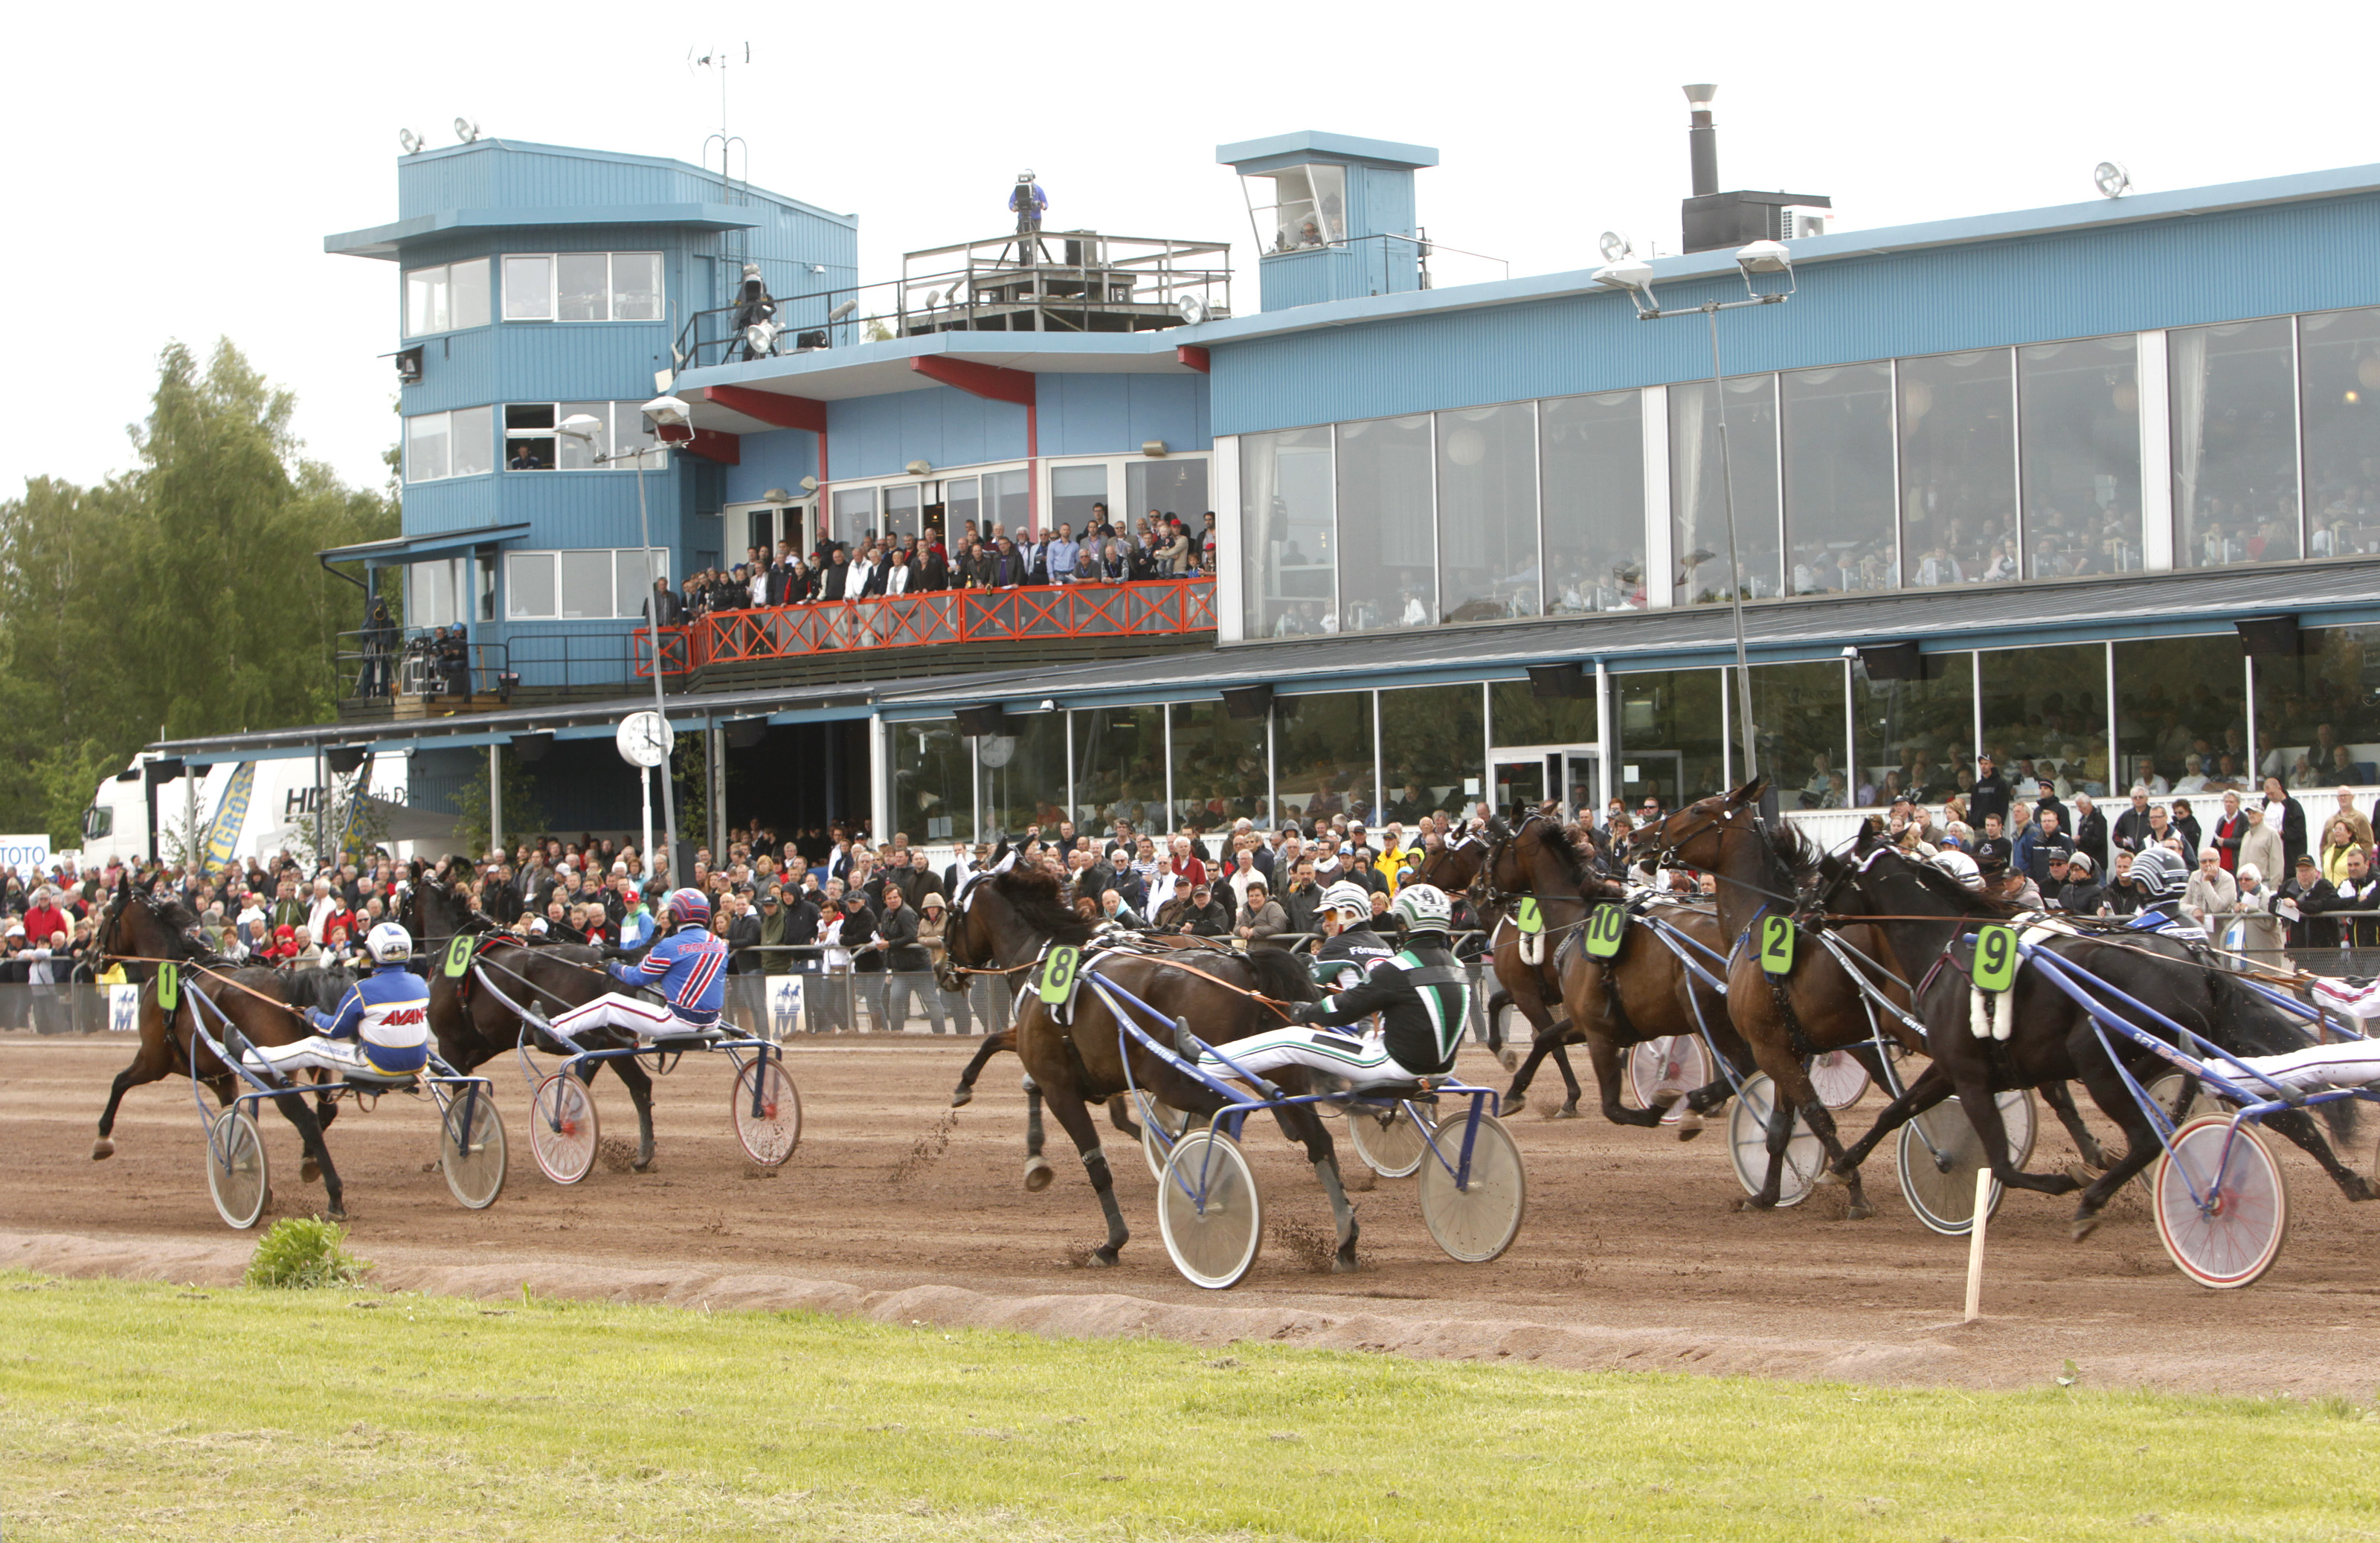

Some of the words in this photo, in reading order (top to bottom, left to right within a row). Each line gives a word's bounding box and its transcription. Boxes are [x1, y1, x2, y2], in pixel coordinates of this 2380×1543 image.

[1592, 904, 1625, 942] 10
[1767, 918, 1787, 958] 2
[453, 936, 469, 966] 6
[678, 942, 727, 956] FRONTLI
[1983, 930, 2007, 975] 9
[164, 964, 171, 996] 1
[1050, 948, 1073, 988] 8
[1145, 1040, 1177, 1064] CUSTOM
